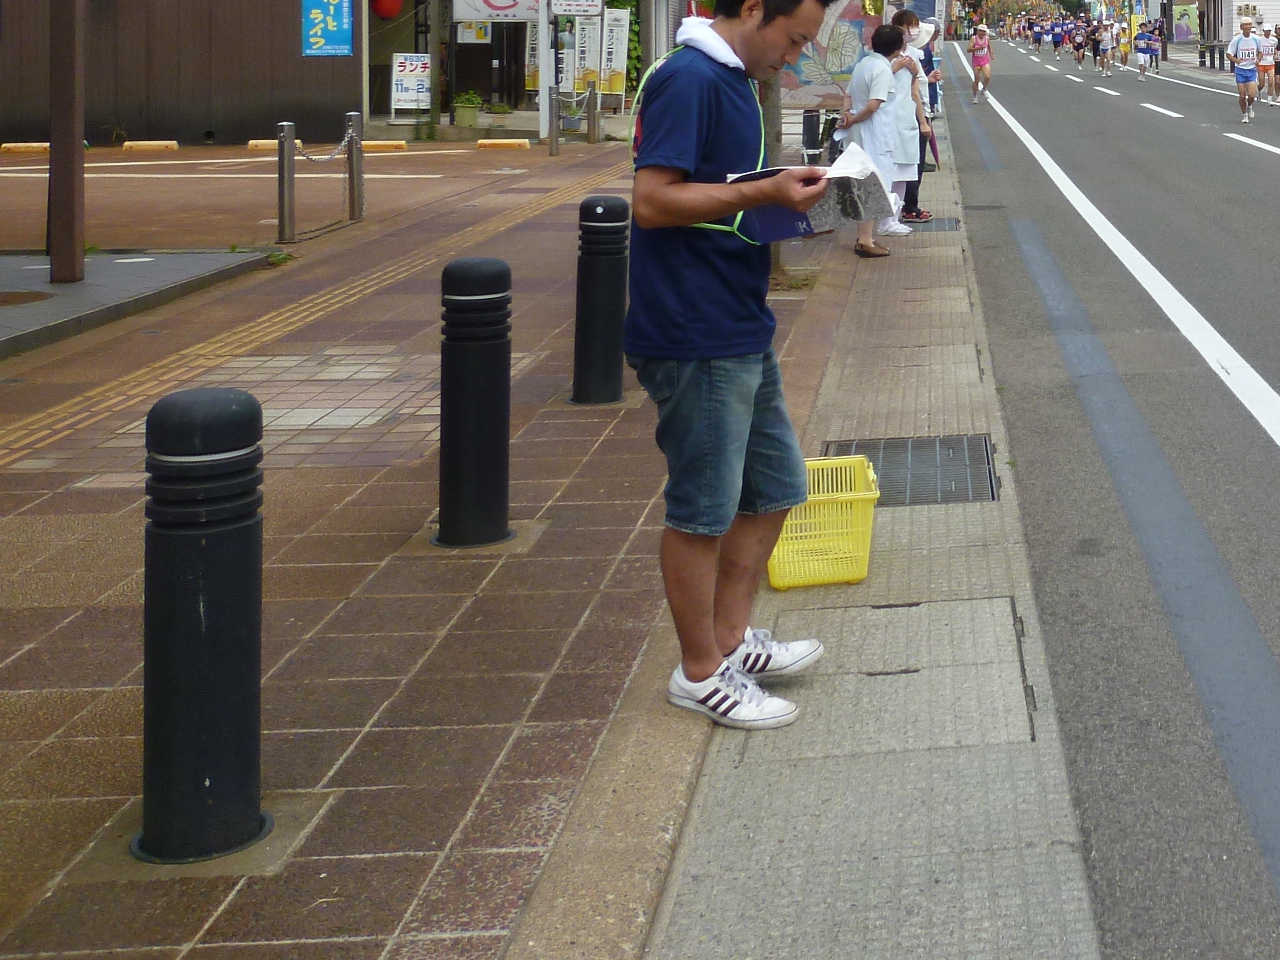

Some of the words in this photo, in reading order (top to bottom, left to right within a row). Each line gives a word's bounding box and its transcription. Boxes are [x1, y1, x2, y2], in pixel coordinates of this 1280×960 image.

[1241, 50, 1255, 59] 1149
[397, 61, 430, 73] ランチ
